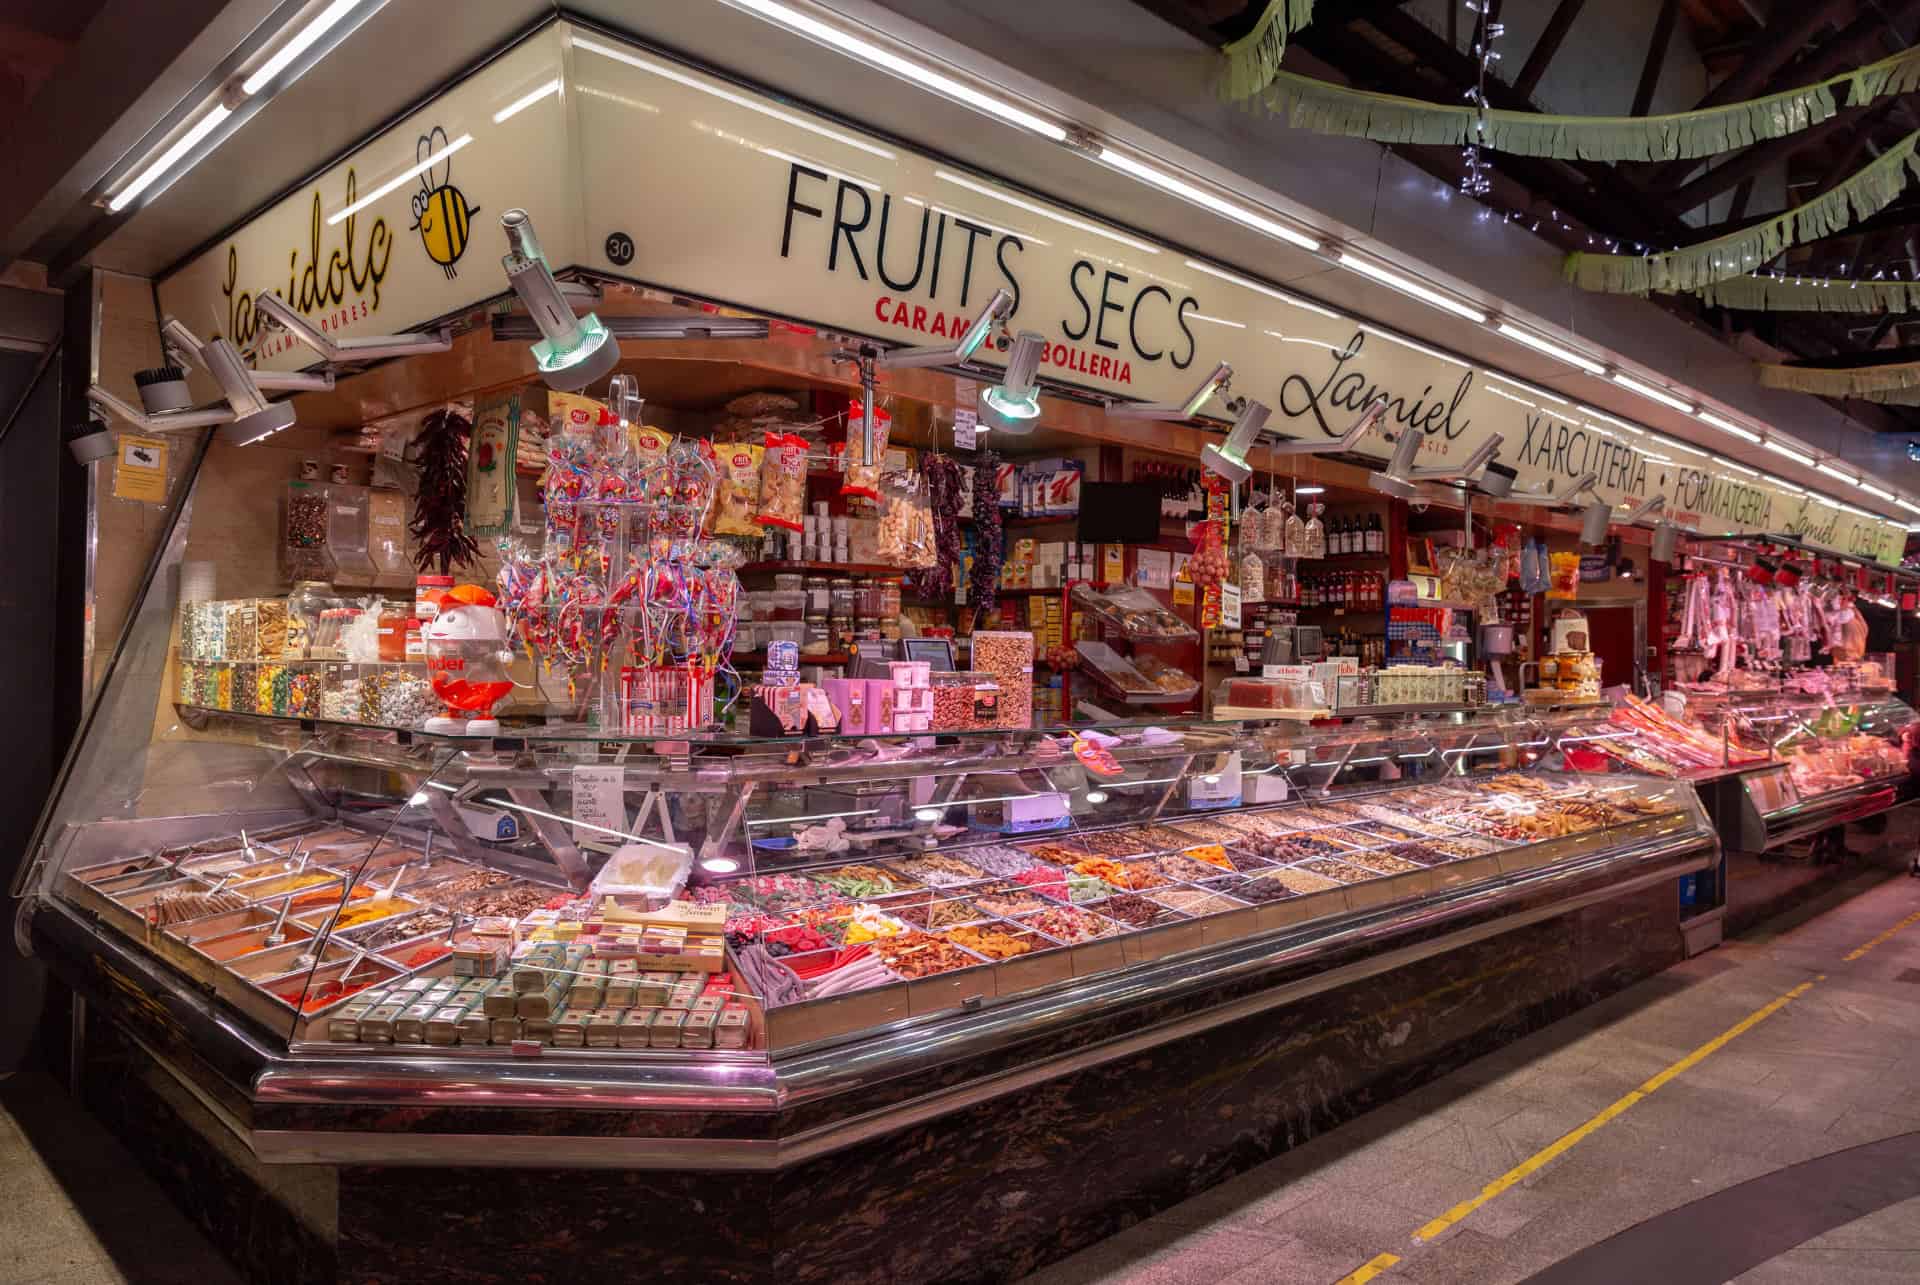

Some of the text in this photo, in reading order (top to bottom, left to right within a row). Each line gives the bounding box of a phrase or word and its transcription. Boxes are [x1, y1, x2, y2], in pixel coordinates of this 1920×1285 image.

[608, 238, 632, 259] 30
[780, 163, 1199, 370] FRUITS SECS
[1041, 341, 1132, 385] BOLLERIA
[1280, 330, 1473, 441] Lamiel
[1518, 414, 1648, 497] XARCUTERIA
[1674, 467, 1773, 530] FORMATGERIA
